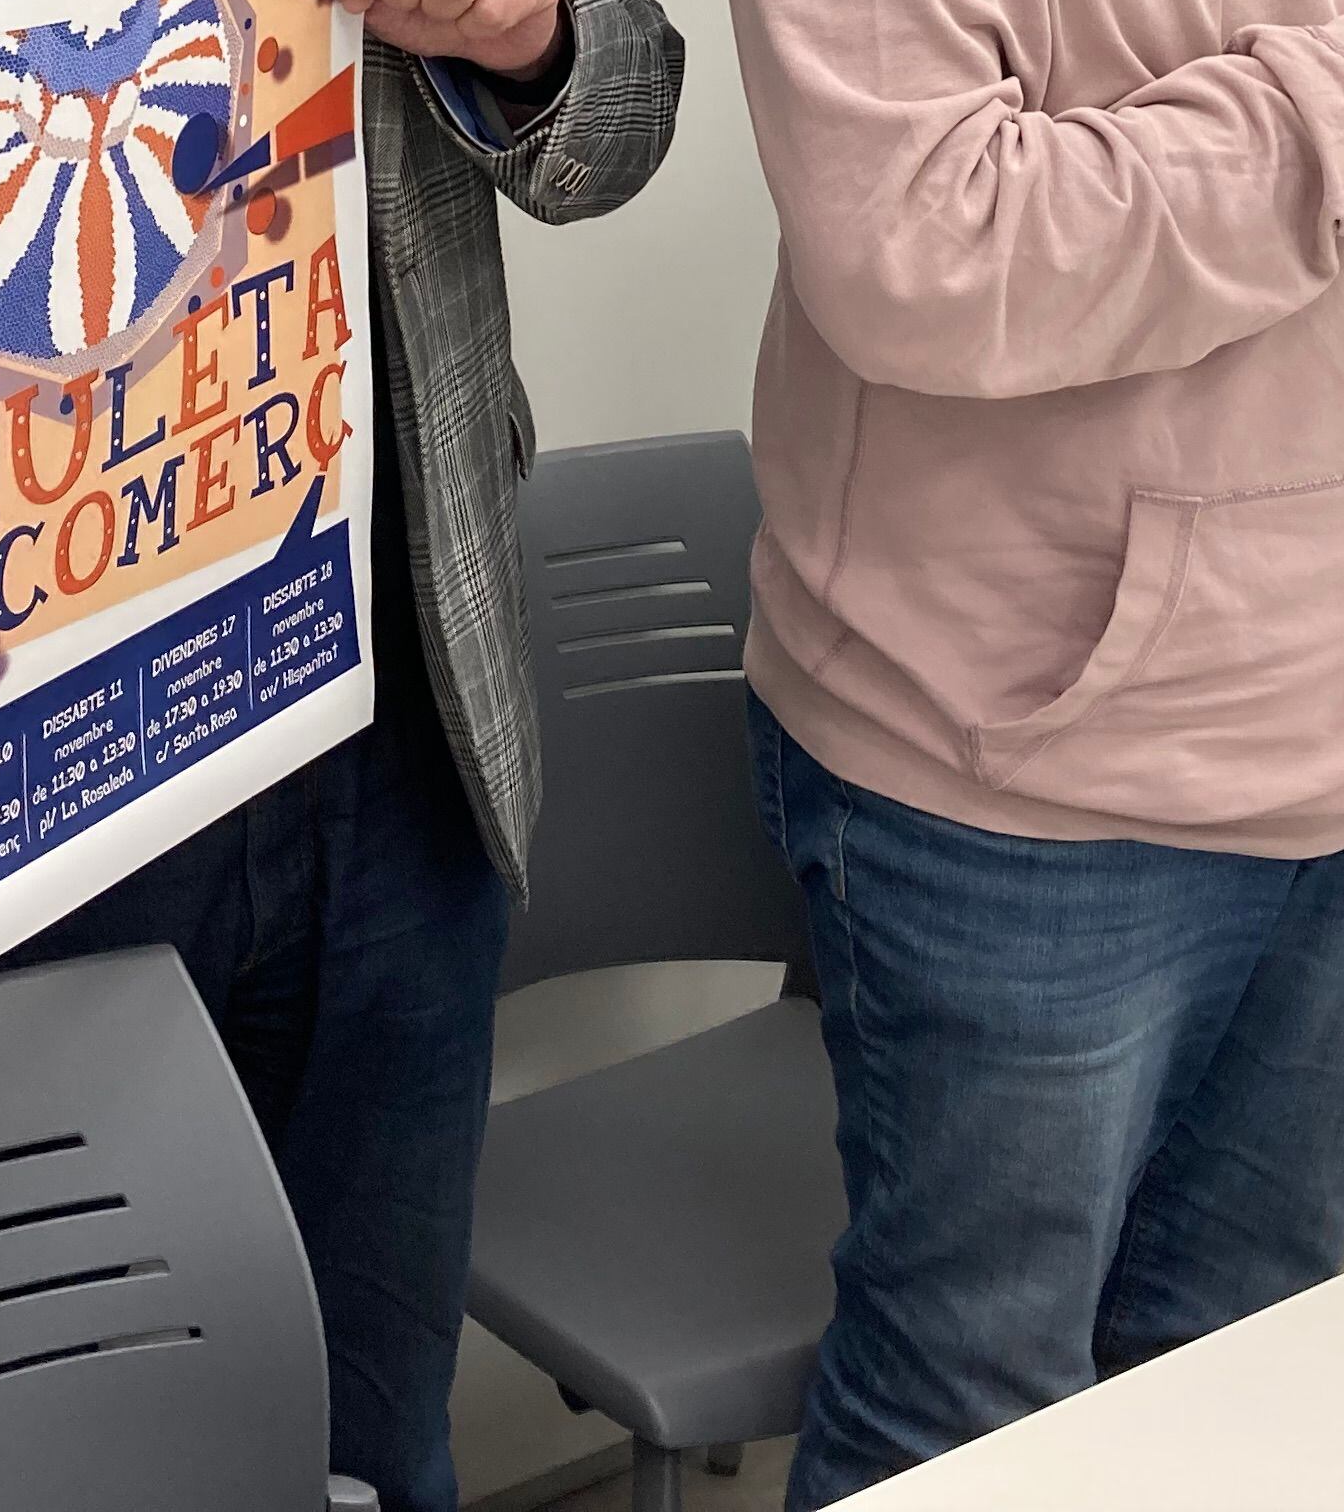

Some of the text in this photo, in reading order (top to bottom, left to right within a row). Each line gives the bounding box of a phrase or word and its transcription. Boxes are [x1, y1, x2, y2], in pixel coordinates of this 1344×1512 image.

[263, 560, 333, 615] DISSABTE 18
[272, 597, 325, 637] novembre
[151, 615, 236, 678] DIVENDRES 17
[253, 656, 267, 677] de
[303, 634, 311, 648] a
[166, 656, 223, 698] novembre
[260, 642, 339, 703] av/ Hispanitat
[42, 678, 124, 739] DISSABTE 11
[146, 718, 161, 739] de
[200, 694, 209, 707] a
[54, 718, 114, 762] novembre
[156, 707, 238, 764] c/ Santa Rosa
[32, 784, 47, 805] de
[89, 758, 98, 772] a
[39, 766, 135, 840] pl/ La Rosaleda
